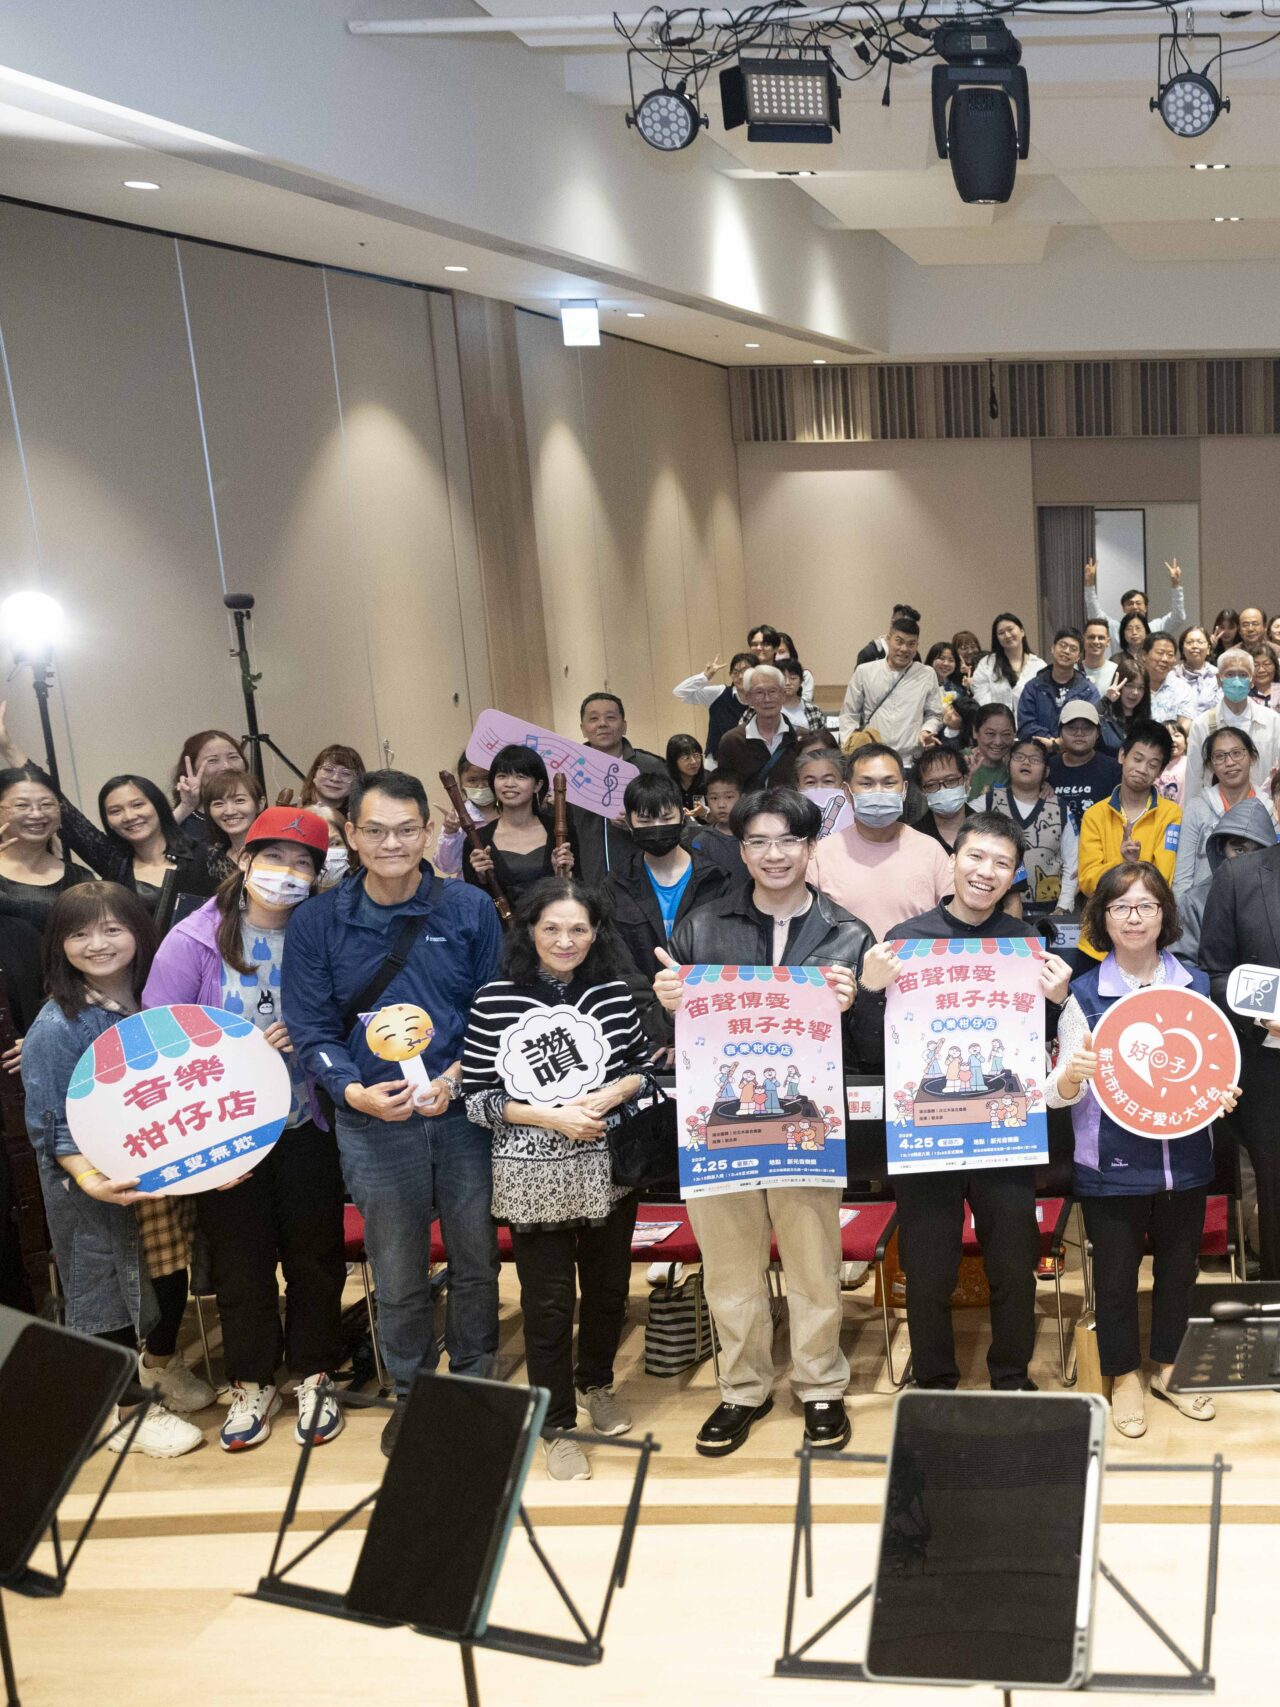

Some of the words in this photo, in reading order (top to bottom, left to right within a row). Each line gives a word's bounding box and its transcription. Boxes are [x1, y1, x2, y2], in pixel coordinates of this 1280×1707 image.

[895, 965, 996, 994] 笛聲傳愛
[684, 991, 790, 1019] 笛聲傳愛
[936, 990, 1037, 1014] 親子共響
[727, 1016, 833, 1042] 親子共響
[932, 1018, 996, 1031] 音樂柑仔店
[520, 1026, 588, 1087] 讚
[725, 1043, 792, 1057] 音樂柑仔店
[1128, 1040, 1150, 1061] 好
[122, 1054, 225, 1111] 音樂
[1098, 1047, 1221, 1127] 新北市好日子愛心大平台
[122, 1090, 257, 1158] 柑仔店
[899, 1137, 933, 1149] 4.25
[159, 1134, 256, 1182] 童叟無欺
[692, 1160, 728, 1174] 4.25
